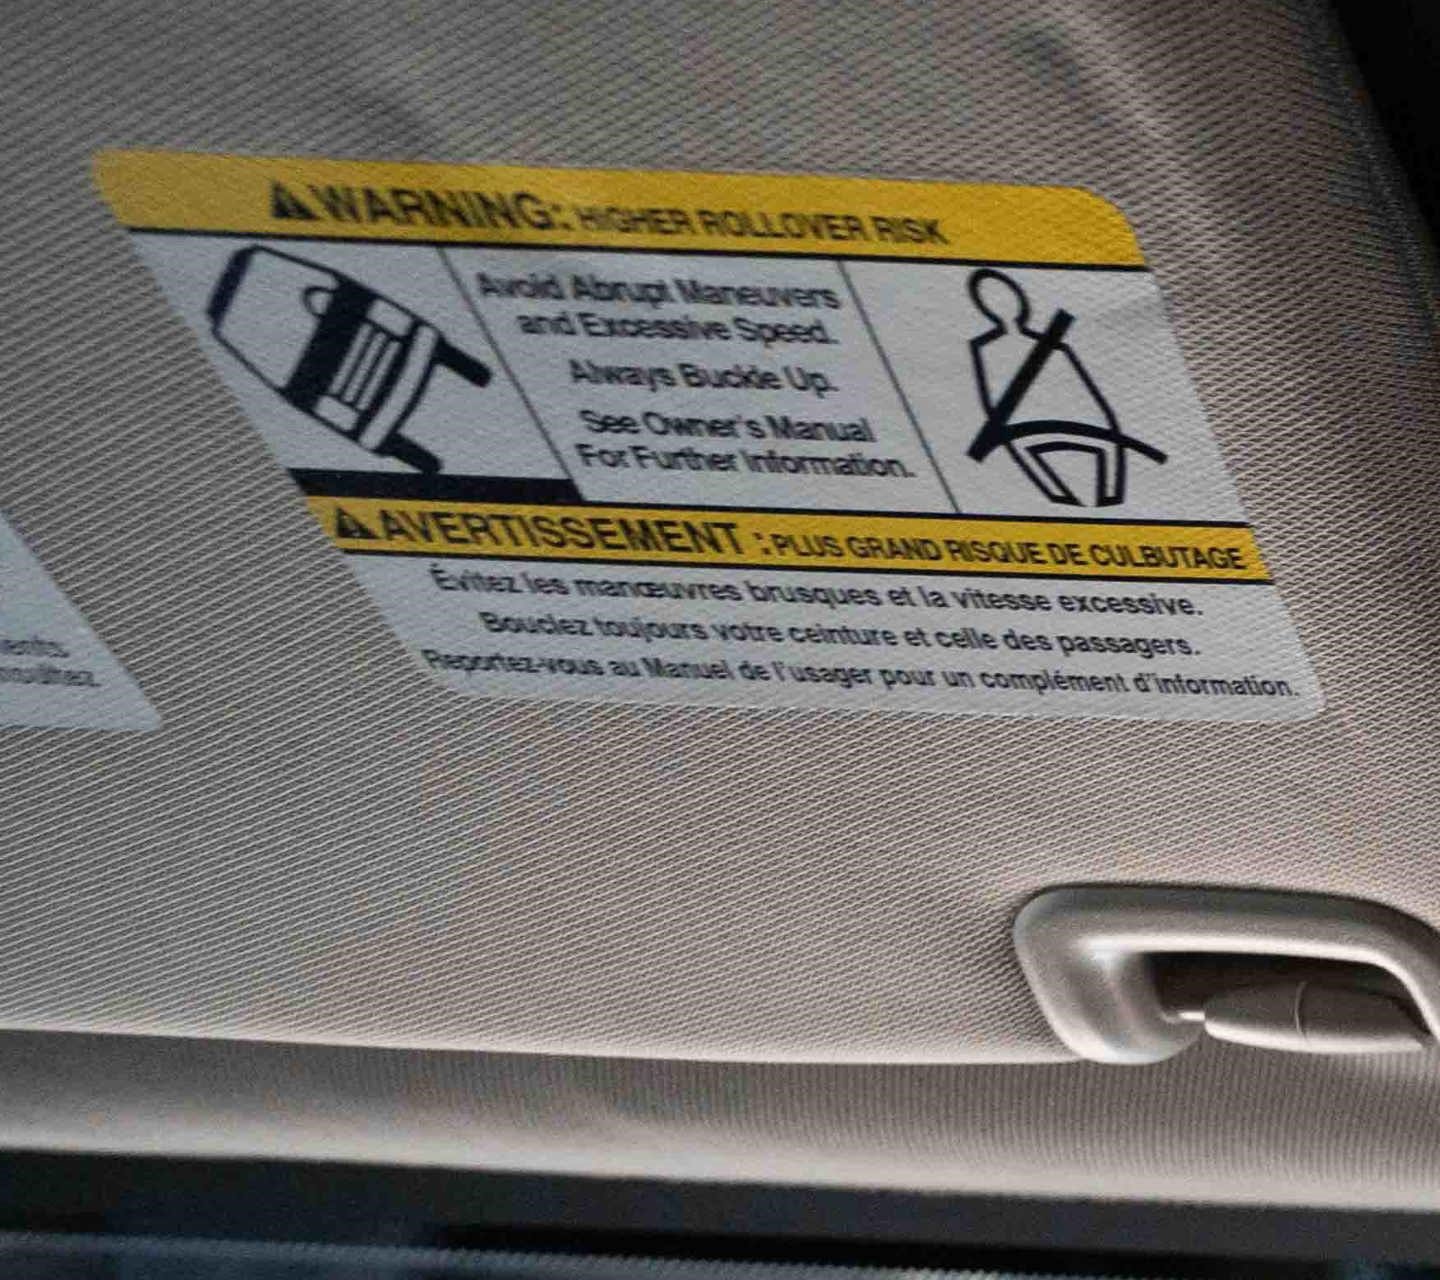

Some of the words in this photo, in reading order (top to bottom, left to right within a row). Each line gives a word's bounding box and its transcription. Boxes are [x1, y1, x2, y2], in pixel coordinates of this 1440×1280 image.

[307, 185, 572, 230] WARNING:
[576, 206, 693, 235] HIGHER
[697, 209, 869, 240] ROLLOVER
[871, 216, 948, 244] RISK
[476, 272, 564, 300] Avoid
[573, 274, 676, 310] Abrupt
[675, 278, 841, 310] Maneuvers
[517, 314, 577, 336] and
[577, 313, 731, 341] Excessive
[732, 318, 839, 348] Speed.
[569, 360, 675, 392] Always
[677, 363, 780, 391] Buckle
[783, 367, 839, 398] Up.
[578, 411, 642, 434] See
[642, 412, 766, 438] Owner's
[767, 416, 877, 443] Manual
[574, 444, 632, 468] For
[633, 446, 740, 473] Further
[742, 450, 916, 478] Information.
[376, 509, 746, 555] AVERTISSEMENT
[774, 534, 845, 559] PLUS
[847, 536, 945, 563] GRAND
[947, 539, 1048, 566] RISQUE
[1051, 542, 1091, 566] DE
[1093, 543, 1246, 570] CULBUTAGE
[430, 563, 516, 592] Évitez
[520, 573, 570, 595] les
[750, 583, 878, 612] brusques
[888, 587, 914, 608] et
[921, 585, 948, 608] la
[954, 589, 1051, 613] vitesse
[1058, 591, 1204, 617] excessive.
[478, 611, 593, 635] Bouclez
[596, 615, 709, 643] toujours
[712, 621, 786, 644] votre
[791, 623, 899, 647] ceinture
[904, 627, 933, 649] et
[934, 626, 998, 650] celle
[1002, 630, 1050, 653] des
[1055, 634, 1201, 659] passagers.
[421, 649, 604, 681] Reportez-vous
[610, 660, 638, 677] au
[641, 656, 735, 681] Manuel
[738, 659, 771, 681] de
[771, 660, 872, 691] l'usager
[879, 666, 935, 690] pour
[941, 670, 977, 690] un
[981, 666, 1128, 697] complément
